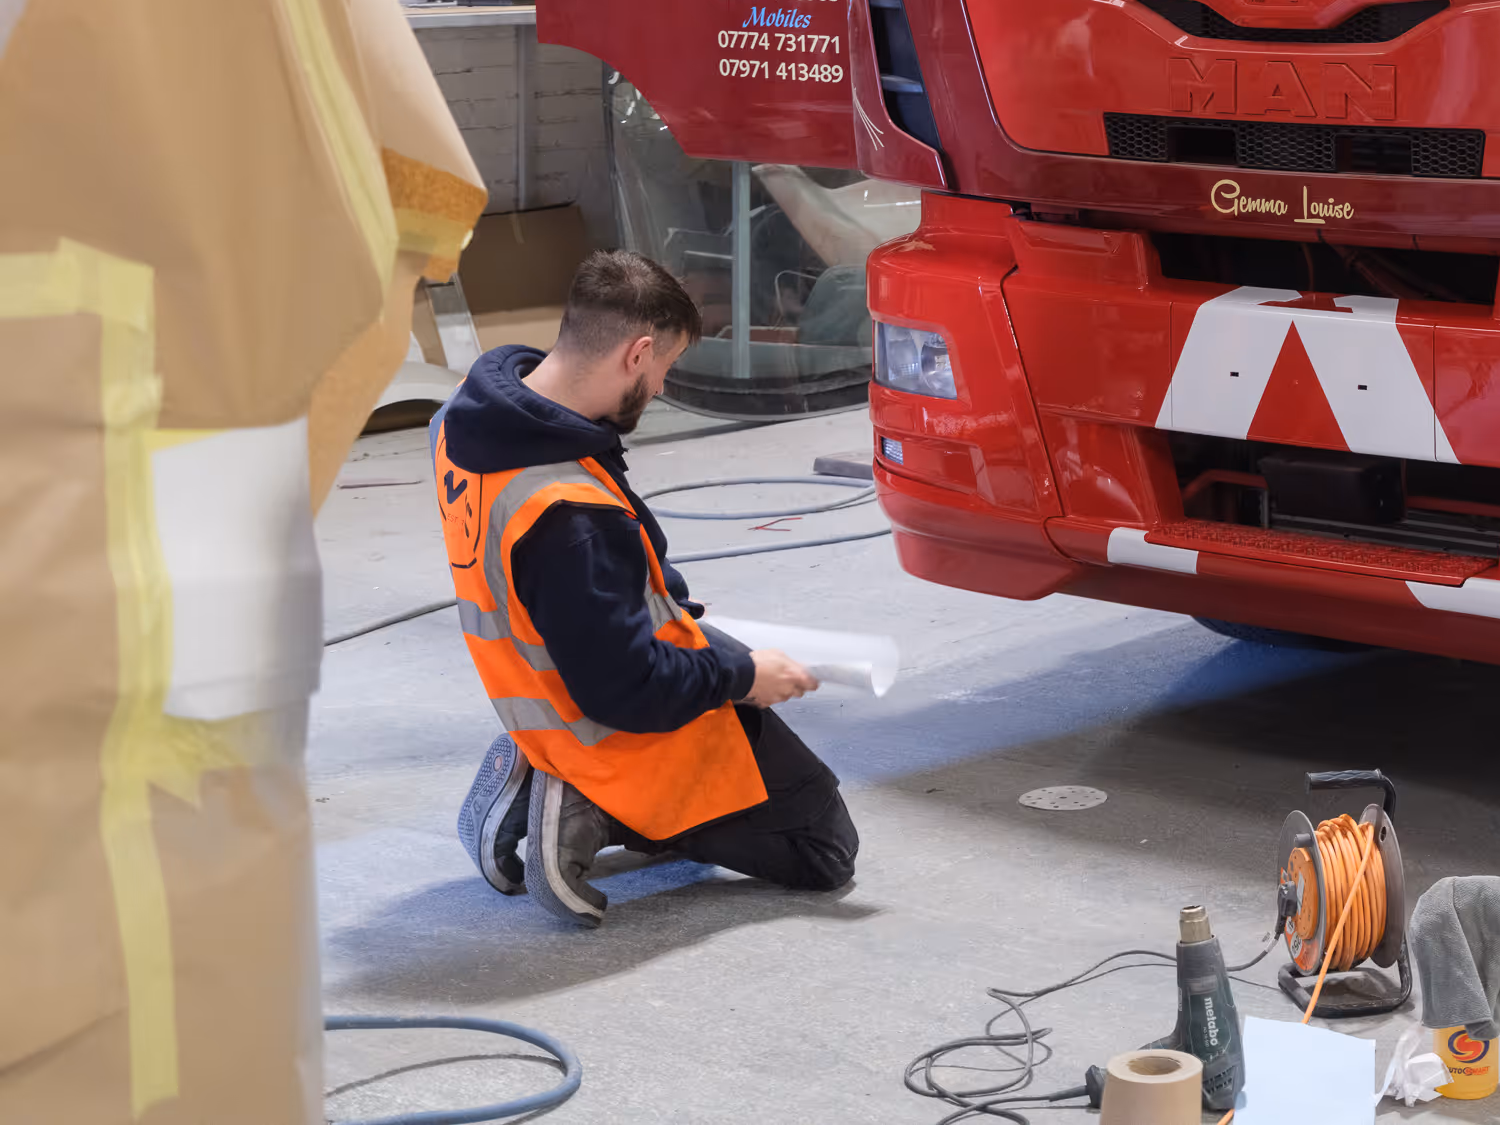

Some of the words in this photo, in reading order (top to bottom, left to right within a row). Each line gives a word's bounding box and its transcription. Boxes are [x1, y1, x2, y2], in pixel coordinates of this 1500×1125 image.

[742, 6, 812, 29] Mobiles
[717, 30, 770, 51] 07774
[775, 32, 840, 54] 731771
[719, 58, 770, 79] 07971
[776, 62, 844, 83] 413489
[1167, 56, 1397, 121] MAN
[1210, 179, 1288, 217] Gemma
[1294, 185, 1355, 224] Louise
[1204, 996, 1219, 1046] metabo
